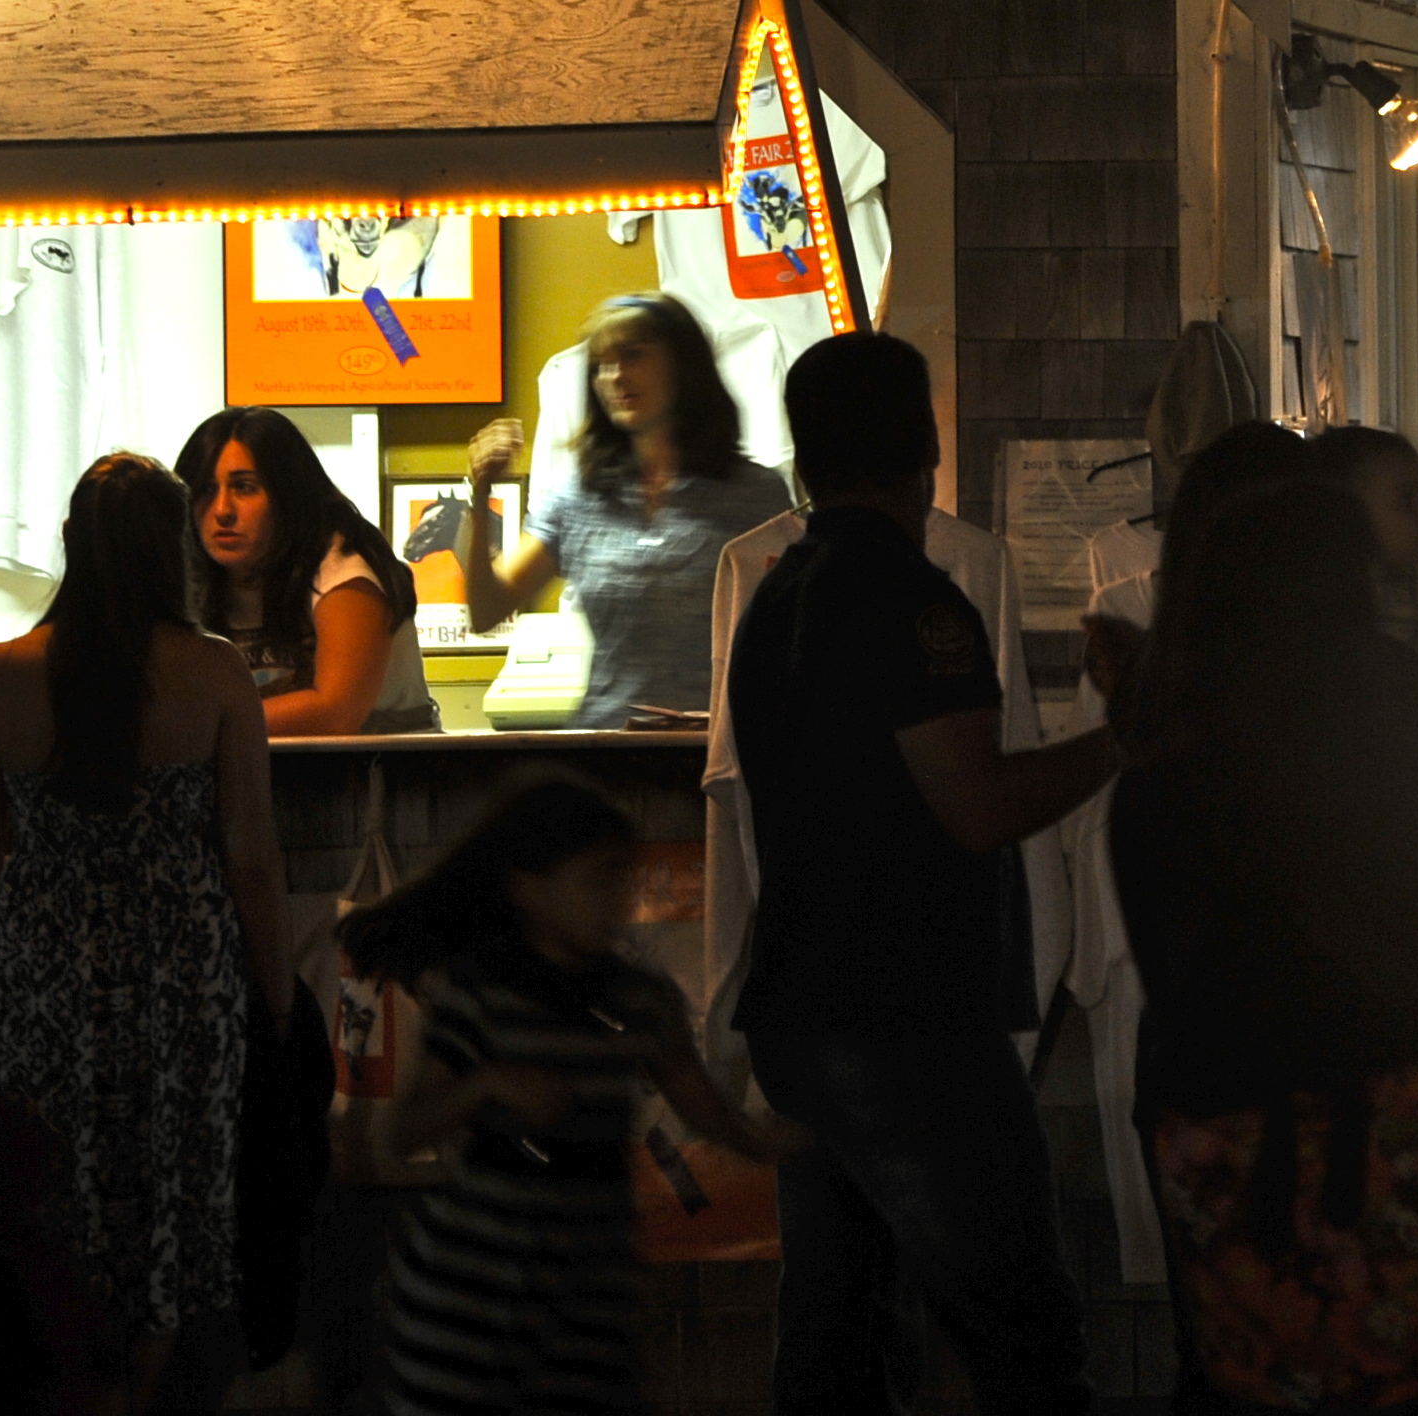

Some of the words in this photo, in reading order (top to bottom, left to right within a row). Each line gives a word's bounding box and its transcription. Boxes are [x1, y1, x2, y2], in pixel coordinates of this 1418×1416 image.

[752, 141, 782, 166] FAIR
[254, 315, 299, 338] August
[439, 311, 473, 332] 22nd
